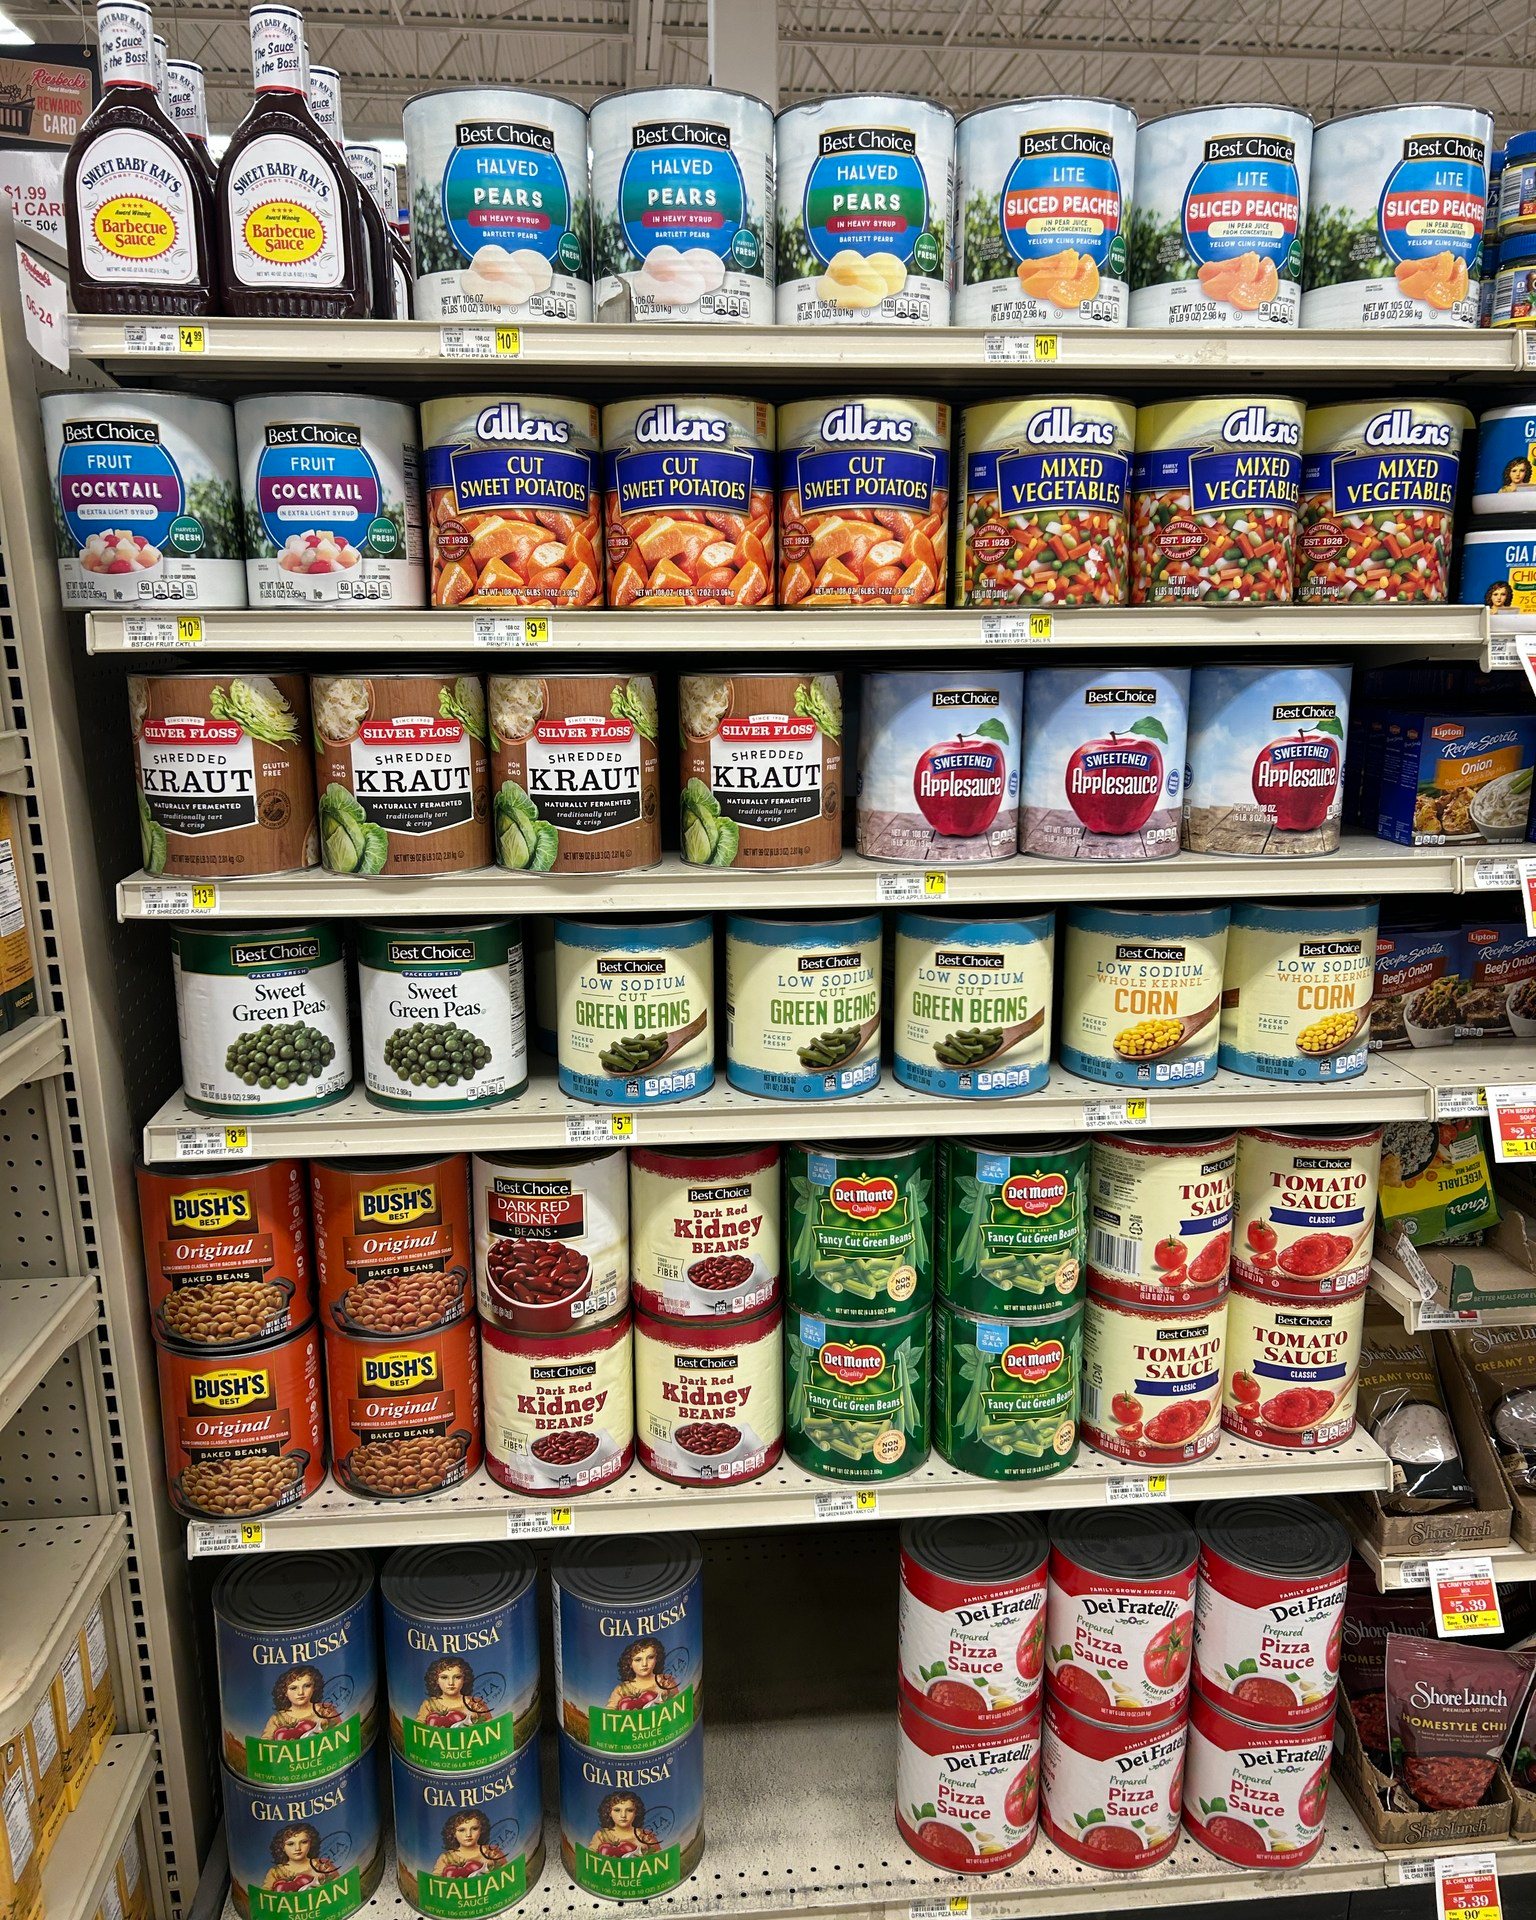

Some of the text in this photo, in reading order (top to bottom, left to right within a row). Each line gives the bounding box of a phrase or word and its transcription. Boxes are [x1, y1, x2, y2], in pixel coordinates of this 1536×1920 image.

[268, 41, 293, 54] Sauce
[262, 61, 275, 74] the
[278, 56, 299, 70] Boss!
[32, 69, 89, 90] Riesbeck's
[37, 96, 82, 115] REWARDS
[44, 114, 76, 135] CARD
[460, 126, 551, 149] Best Choice
[1025, 136, 1111, 154] Best Choice
[82, 160, 114, 190] SWEET
[116, 158, 148, 172] BABY
[149, 163, 182, 192] RAY'S
[477, 159, 538, 176] HALVED
[1053, 167, 1084, 182] LITE
[5, 186, 46, 200] $1.99
[474, 188, 543, 208] PEARS
[1007, 196, 1118, 216] SLICED PEACHES
[37, 220, 58, 231] 50¢
[102, 219, 167, 235] Barbecue
[479, 214, 540, 225] IN HEAVY SYRUP
[1045, 219, 1088, 227] IN PEAR JUICE
[116, 234, 155, 247] Sauce
[1028, 238, 1054, 246] YELLOW
[1076, 238, 1102, 246] PEACHES
[562, 250, 580, 260] FRESH
[25, 295, 54, 329] 06-24
[66, 424, 155, 441] Best Choice
[88, 455, 132, 469] FRUIT
[507, 456, 544, 475] CUT
[1377, 459, 1439, 481] MIXED
[71, 482, 162, 500] COCKTAIL
[461, 478, 585, 502] SWEET POTATOES
[1347, 480, 1452, 504] VEGETABLES
[88, 508, 106, 516] EXTRA
[130, 508, 154, 516] SYRUP
[173, 532, 201, 542] FRESH
[1304, 536, 1321, 547] EST.
[1276, 706, 1336, 719] Best Choice
[145, 727, 238, 739] SILVER FLOSS
[1434, 727, 1462, 737] Lipton
[1442, 730, 1519, 758] Recipe Secrets
[153, 753, 227, 765] SHREDDED
[1274, 747, 1329, 760] SWEETENED
[262, 762, 290, 770] GLUTEN
[263, 769, 282, 777] FREE
[1461, 757, 1493, 776] Onion
[143, 768, 252, 793] KRAUT
[1258, 760, 1337, 788] Applesauce
[154, 802, 241, 811] NATURALLY FERMENTED
[392, 946, 474, 960] Best Choice
[599, 961, 664, 972] Best Choice
[581, 976, 686, 991] LOW SODIUM
[1097, 975, 1202, 988] WHOLE KERNEL
[408, 982, 458, 1000] Sweet
[618, 992, 647, 1002] CUT
[1115, 989, 1178, 1014] CORN
[389, 1000, 481, 1019] Green Peas
[576, 1000, 690, 1029] GREEN BEANS
[572, 1034, 594, 1043] PACKED
[572, 1041, 590, 1049] FRESH
[1296, 1160, 1350, 1169] Best Choice
[812, 1172, 832, 1181] SALT
[1270, 1172, 1367, 1190] TOMATO
[1438, 1170, 1484, 1191] VEGETABLE
[496, 1181, 570, 1195] Best Choice
[835, 1188, 893, 1201] Del Monte
[363, 1188, 433, 1212] BUSH'S
[498, 1198, 570, 1212] DARK RED
[1281, 1193, 1356, 1209] SAUCE
[1449, 1196, 1489, 1214] Knorr
[389, 1212, 409, 1220] BEST
[852, 1204, 876, 1214] Quality
[505, 1212, 561, 1224] KIDNEY
[1309, 1216, 1336, 1224] CLASSIC
[514, 1227, 551, 1236] BEANS
[363, 1231, 438, 1255] Original
[819, 1232, 912, 1247] Fancy Cut Green Beans
[368, 1263, 434, 1277] BAKED BEANS
[895, 1277, 911, 1285] NON
[895, 1282, 911, 1291] GMO
[649, 1425, 667, 1440] FIBER
[1082, 1598, 1177, 1619] Dei Fratelli
[1450, 1599, 1487, 1613] $5.39
[599, 1602, 686, 1637] GIA RUSSA
[1077, 1614, 1115, 1636] Prepared
[1075, 1627, 1122, 1654] Pizza
[1074, 1642, 1129, 1671] Sauce
[1411, 1681, 1507, 1709] Shore Lunch
[602, 1696, 686, 1734] ITALIAN
[1402, 1713, 1477, 1731] HOMESTYLE
[631, 1728, 662, 1741] SAUCE
[1453, 1895, 1488, 1908] $5.39
